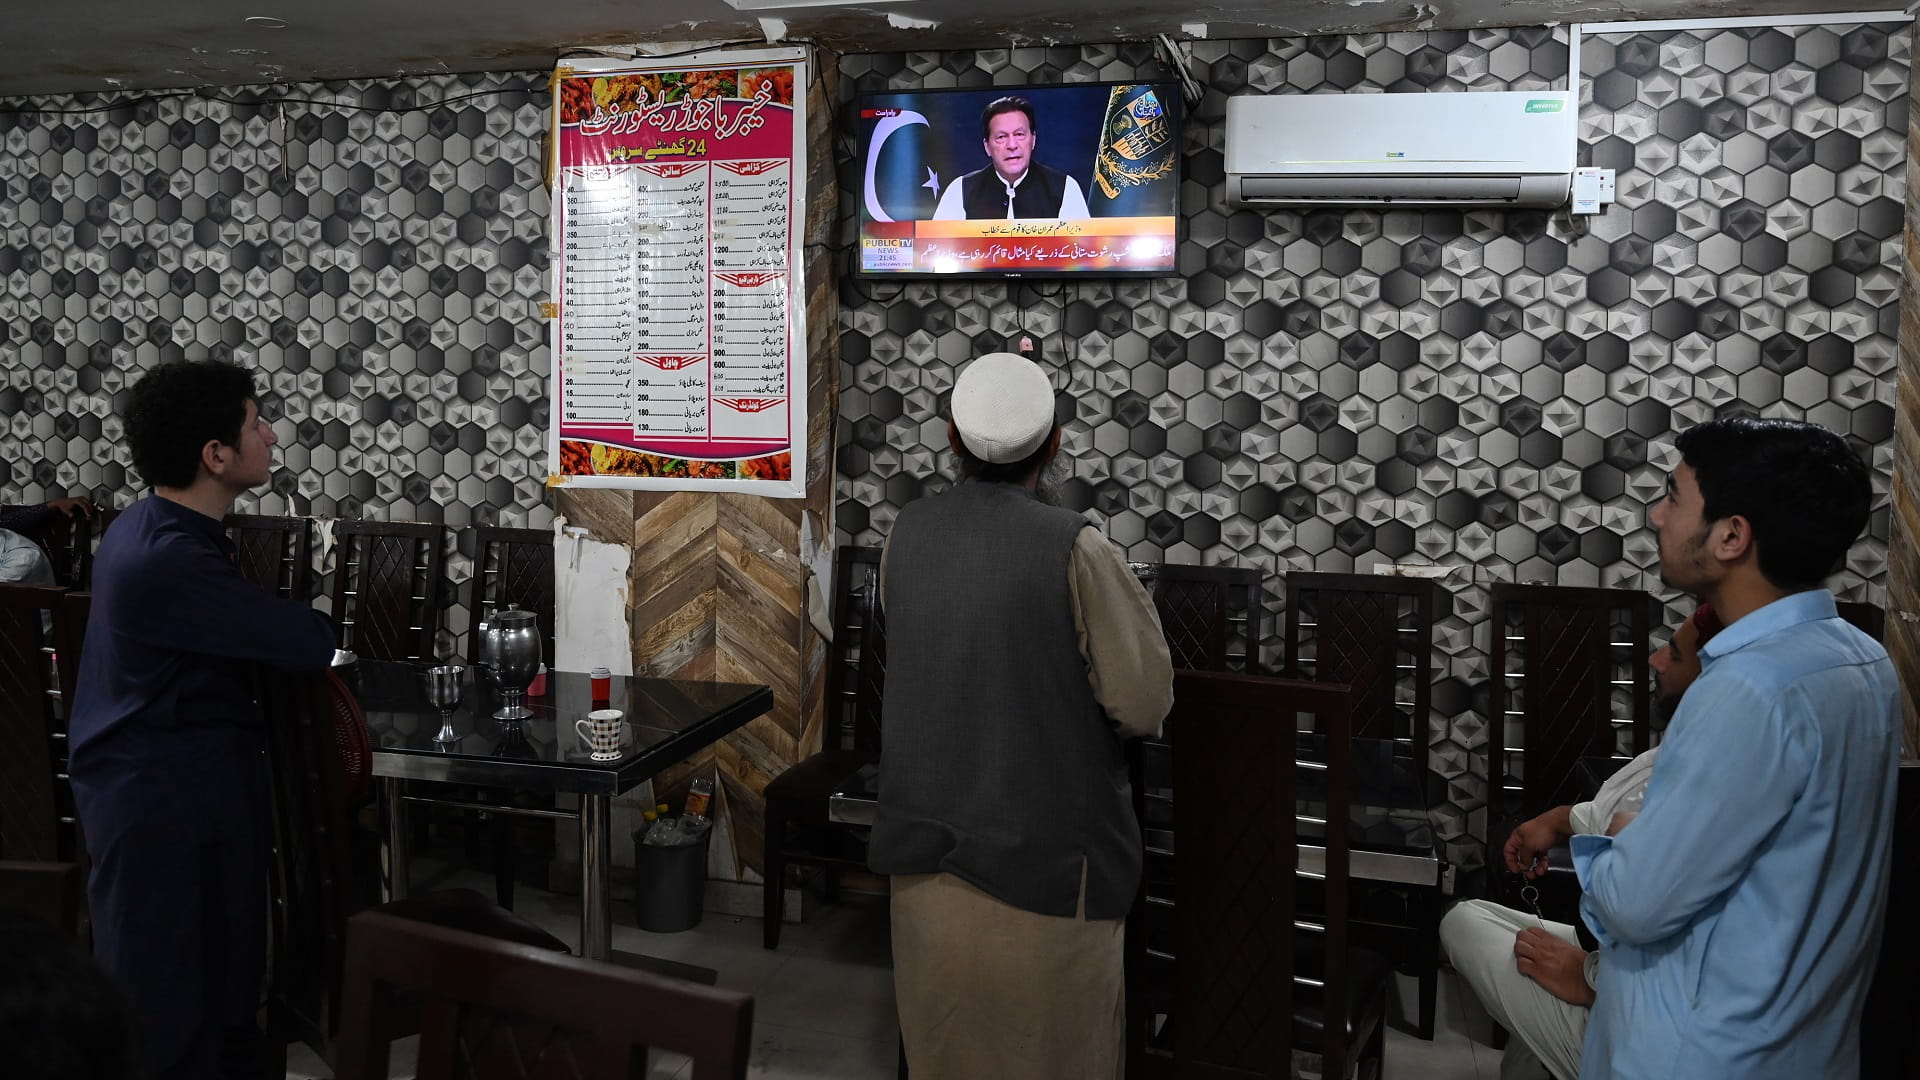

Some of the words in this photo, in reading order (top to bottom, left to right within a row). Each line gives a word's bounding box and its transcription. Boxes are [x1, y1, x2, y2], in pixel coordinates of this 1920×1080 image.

[579, 86, 676, 135] ریسٹورنٹ
[724, 79, 771, 139] خیبر
[645, 137, 686, 160] گھنٹے
[687, 139, 706, 157] 24
[982, 225, 1000, 236] خطاب
[1026, 226, 1037, 234] خان
[637, 238, 649, 246] 200
[1008, 245, 1025, 260] مثال
[1025, 245, 1037, 260] کیا
[1035, 248, 1058, 261] ذریعے
[1058, 245, 1070, 258] کے
[638, 290, 648, 298] 100
[713, 289, 725, 297] 200
[638, 303, 648, 311] 100
[638, 316, 648, 324] 100
[713, 349, 725, 357] 900
[663, 357, 679, 369] چاول
[713, 361, 725, 369] 600
[637, 379, 648, 387] 350
